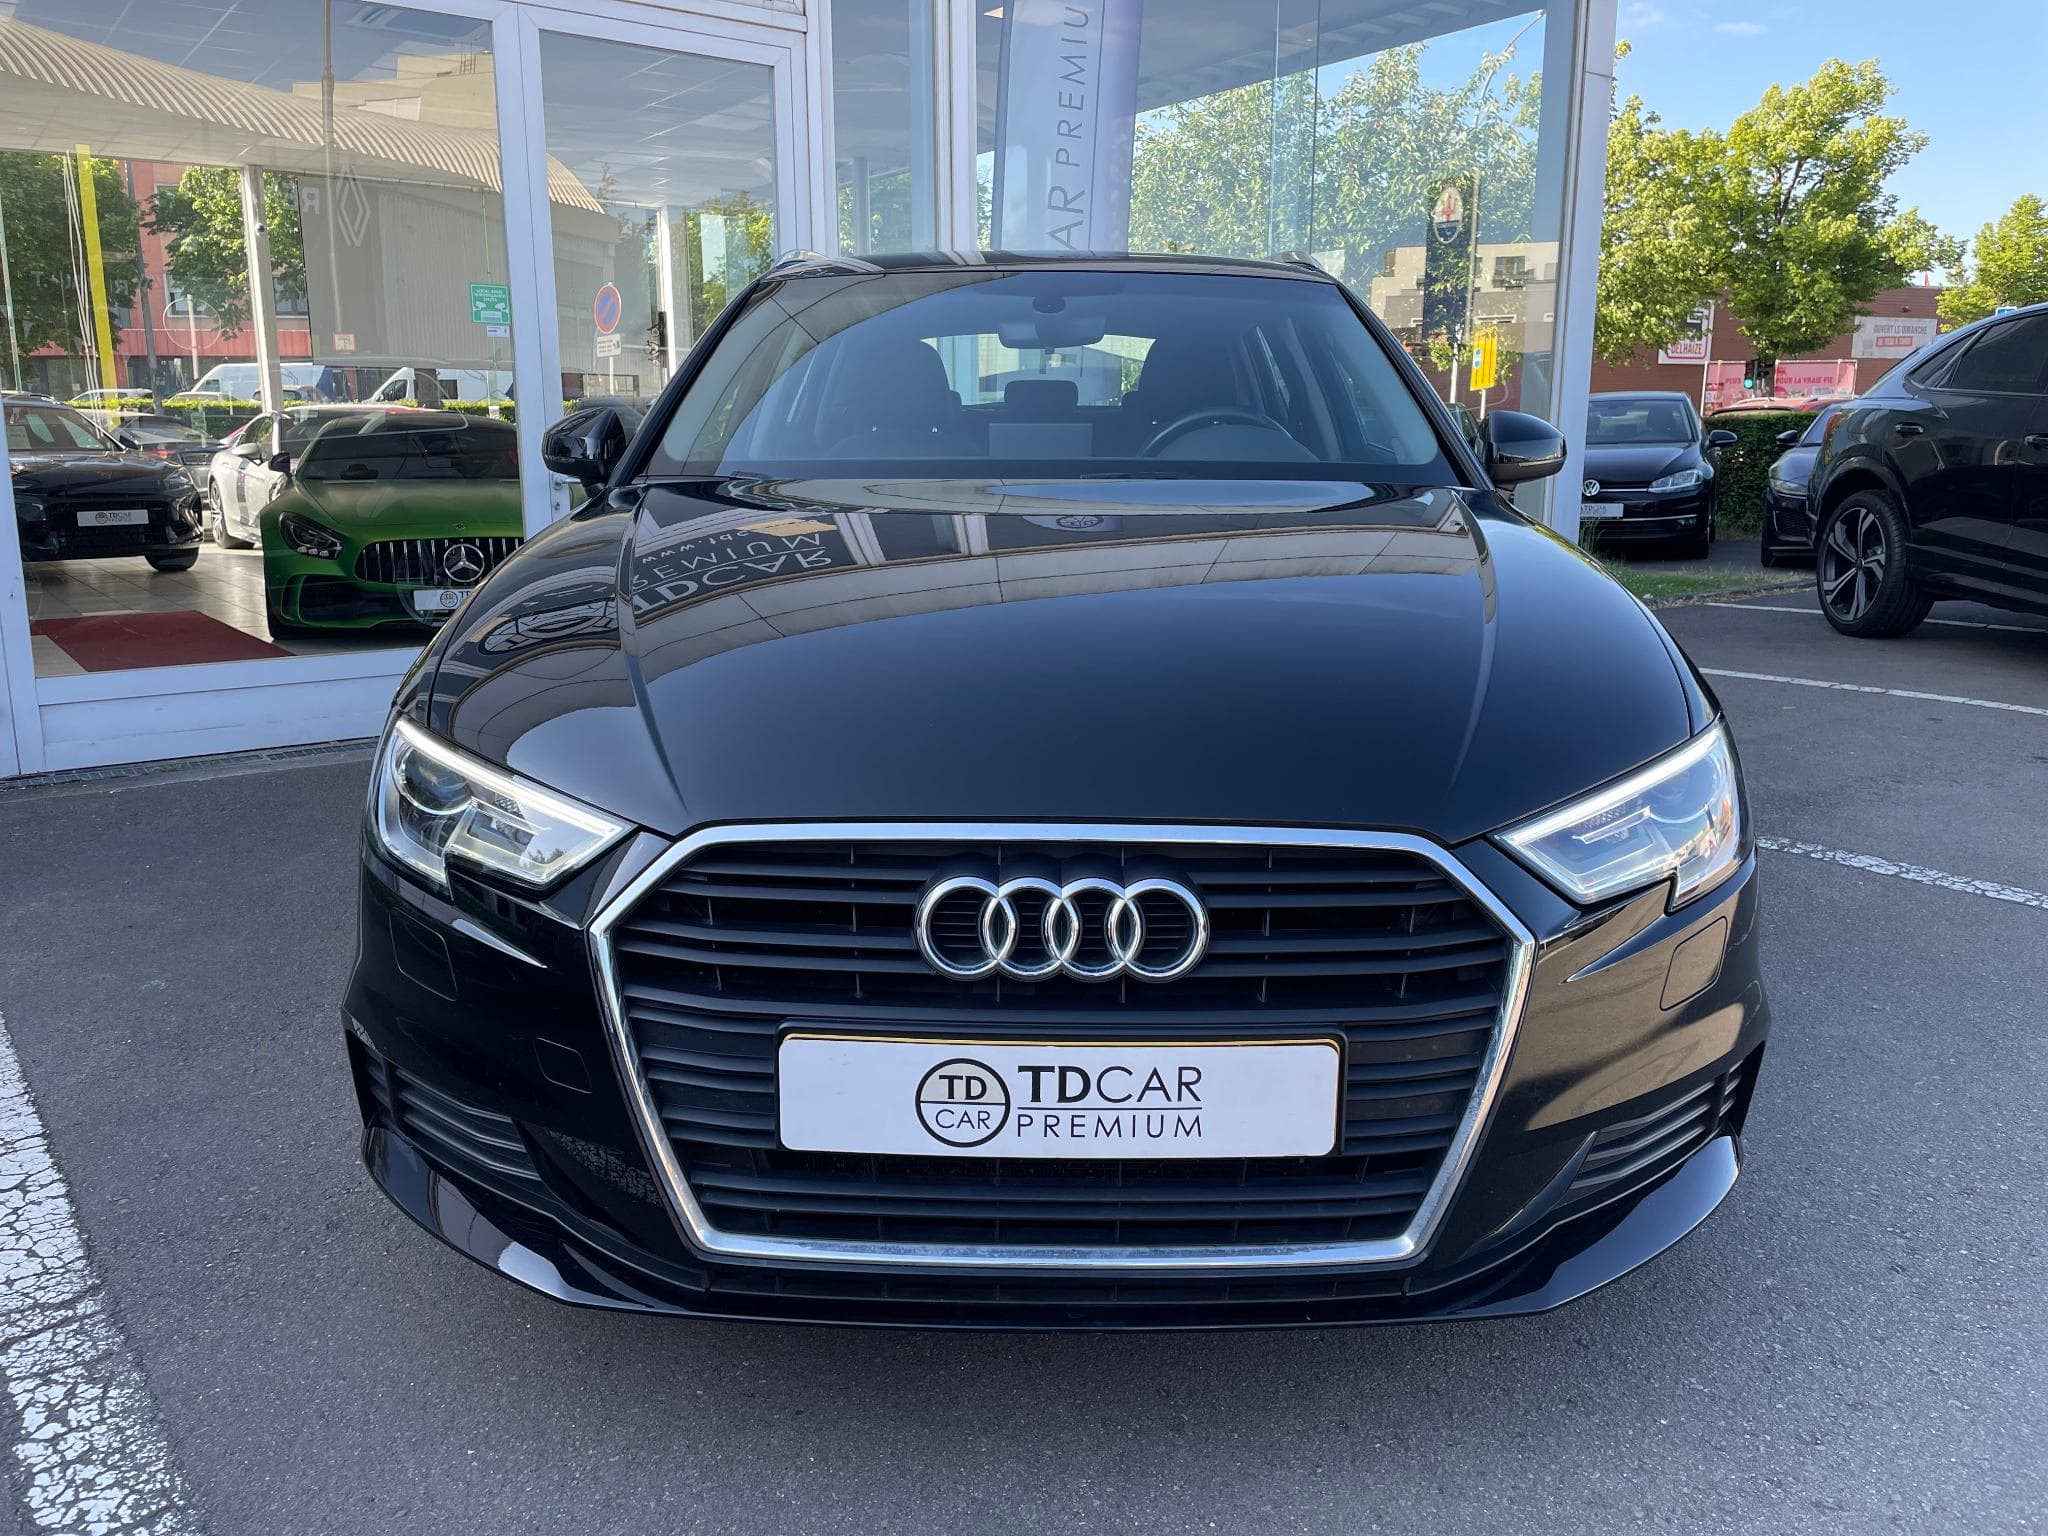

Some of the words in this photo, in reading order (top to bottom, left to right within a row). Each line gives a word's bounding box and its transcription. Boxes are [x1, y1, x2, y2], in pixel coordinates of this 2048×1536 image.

[1056, 6, 1089, 167] PREMIU
[1046, 185, 1086, 251] AR
[1874, 324, 1893, 334] OUVERT
[1901, 325, 1927, 335] DIMANCHE
[1776, 377, 1793, 385] POUR
[1794, 377, 1803, 385] LA
[1803, 376, 1822, 384] VRAIE
[1823, 376, 1833, 384] VIE
[938, 1074, 987, 1101] TD
[1017, 1065, 1202, 1103] TDCAR
[935, 1109, 991, 1129] CAR
[1017, 1114, 1202, 1138] PREMIUM
